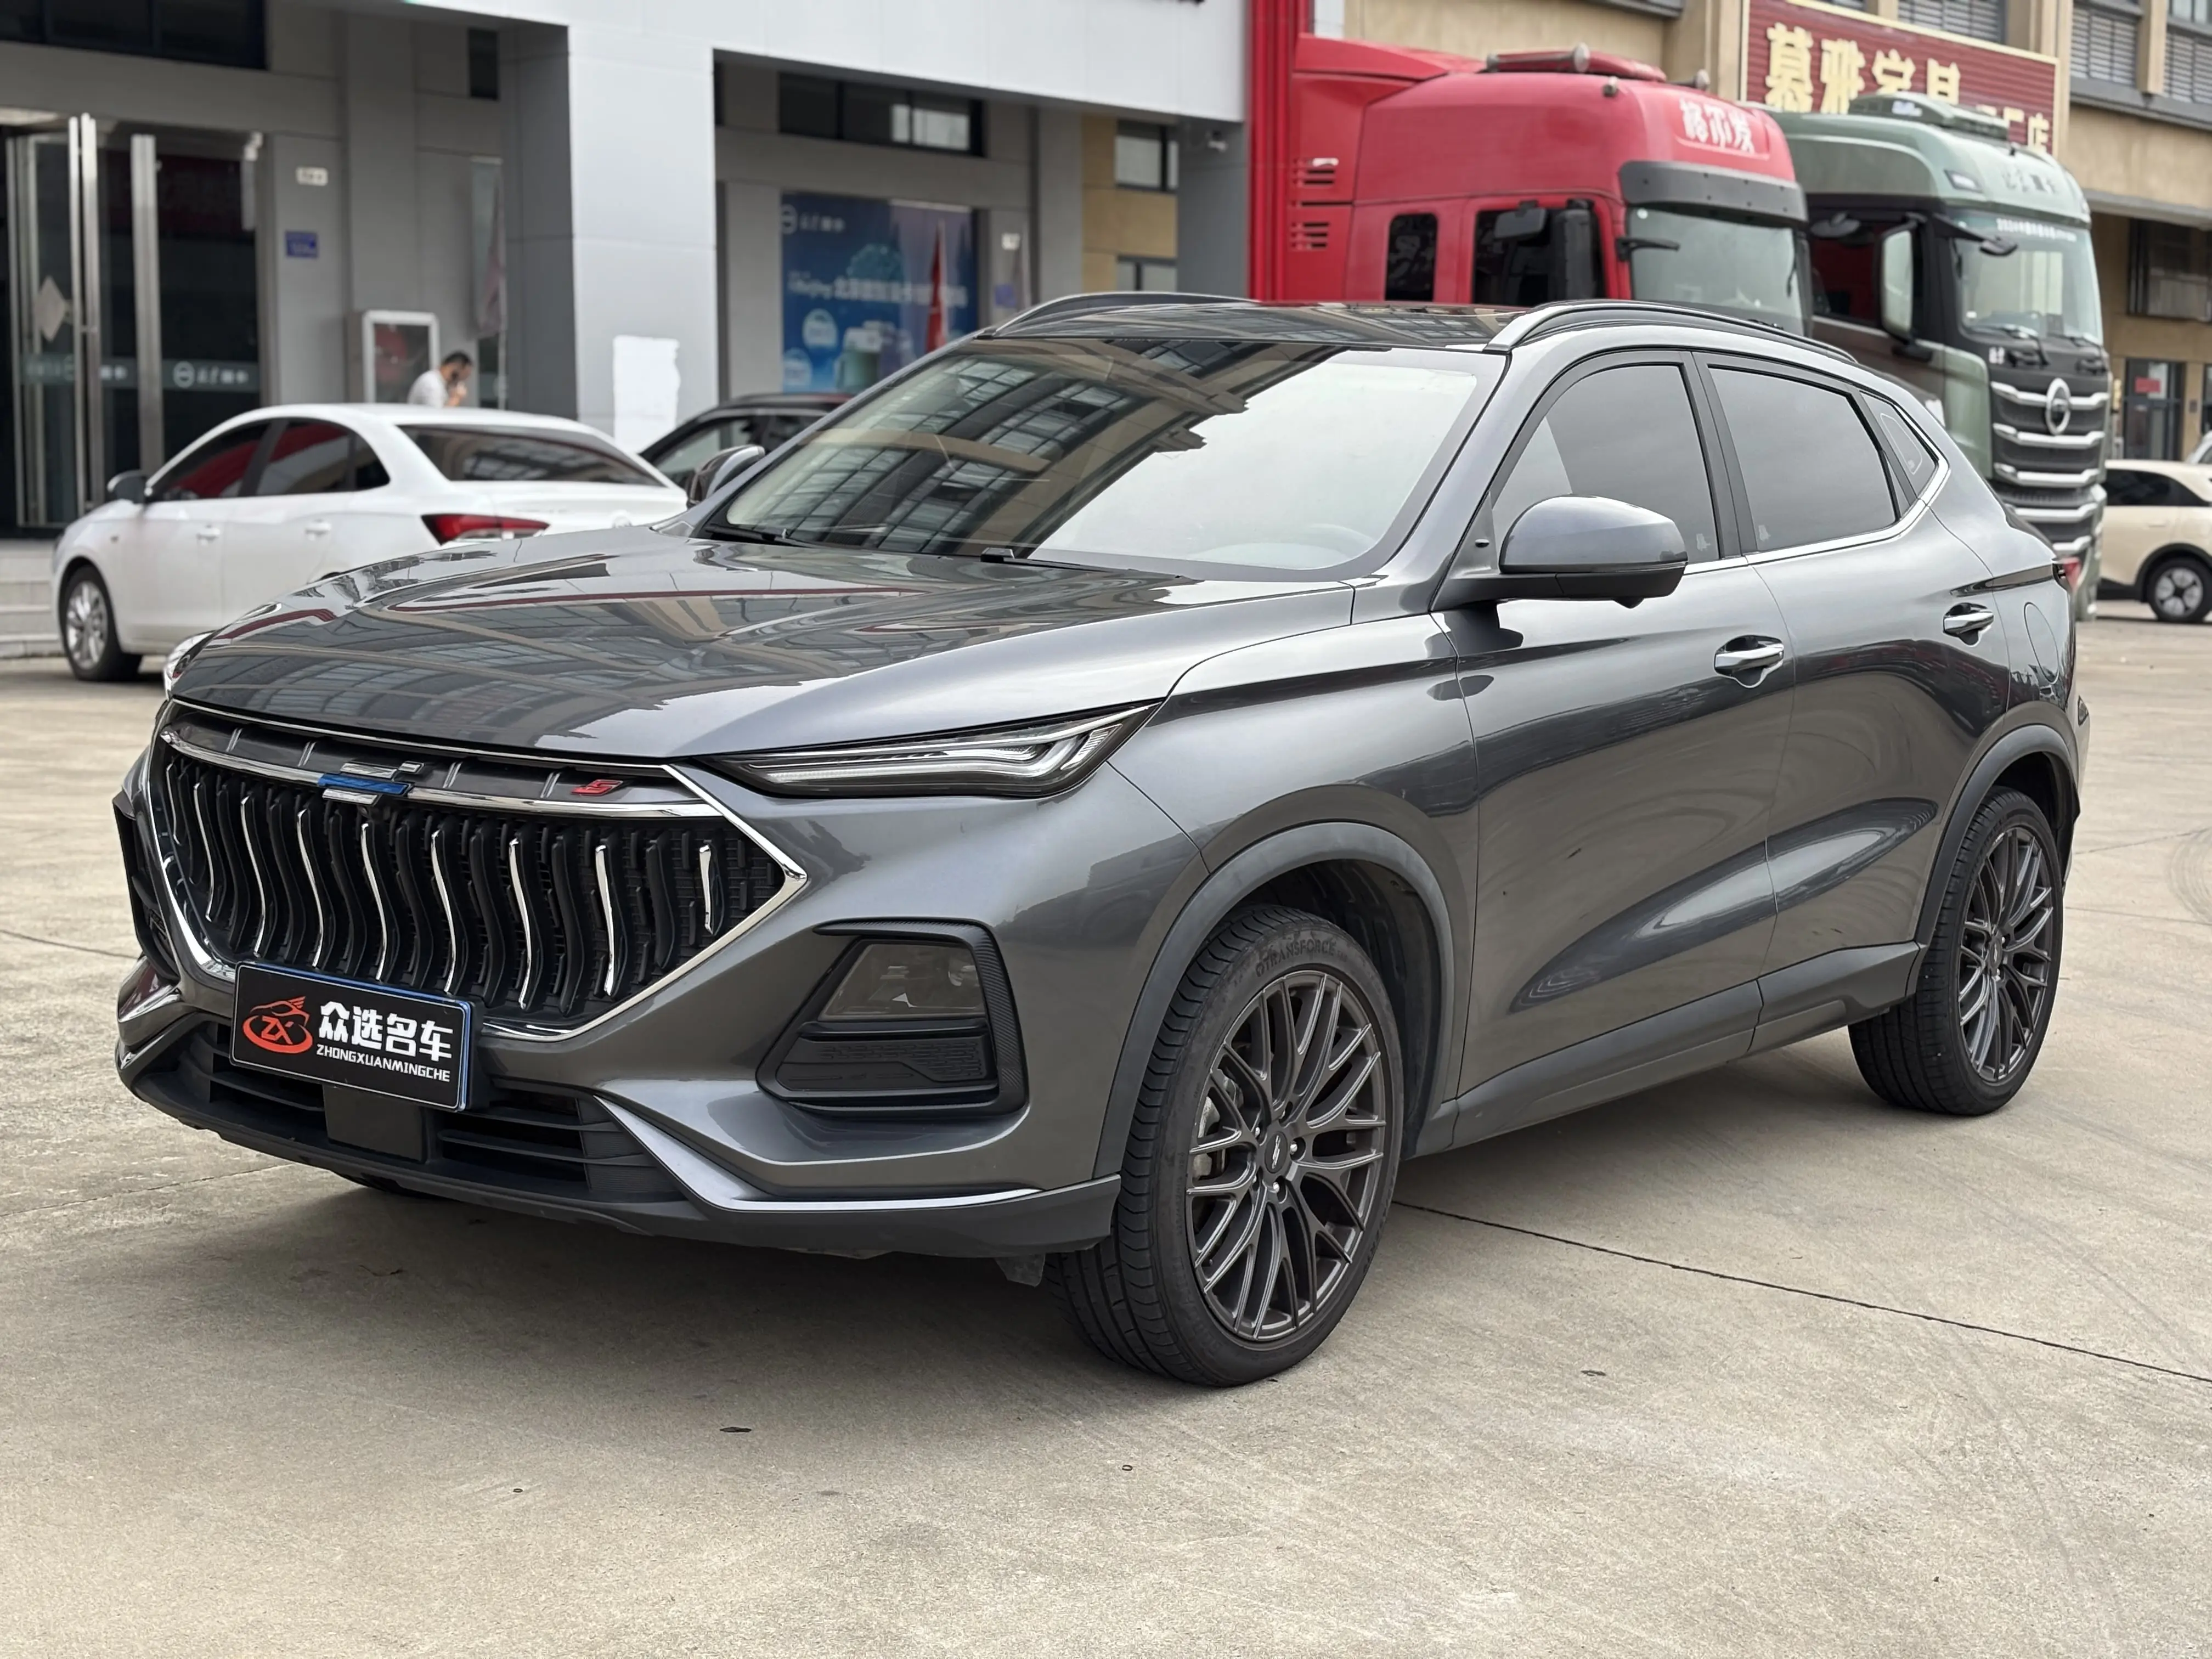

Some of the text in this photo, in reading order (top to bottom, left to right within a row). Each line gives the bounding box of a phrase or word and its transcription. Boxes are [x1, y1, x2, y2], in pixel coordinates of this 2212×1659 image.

[319, 1001, 453, 1062] 众选名车
[317, 1044, 450, 1082] ZHONGXUANMINGCHE
